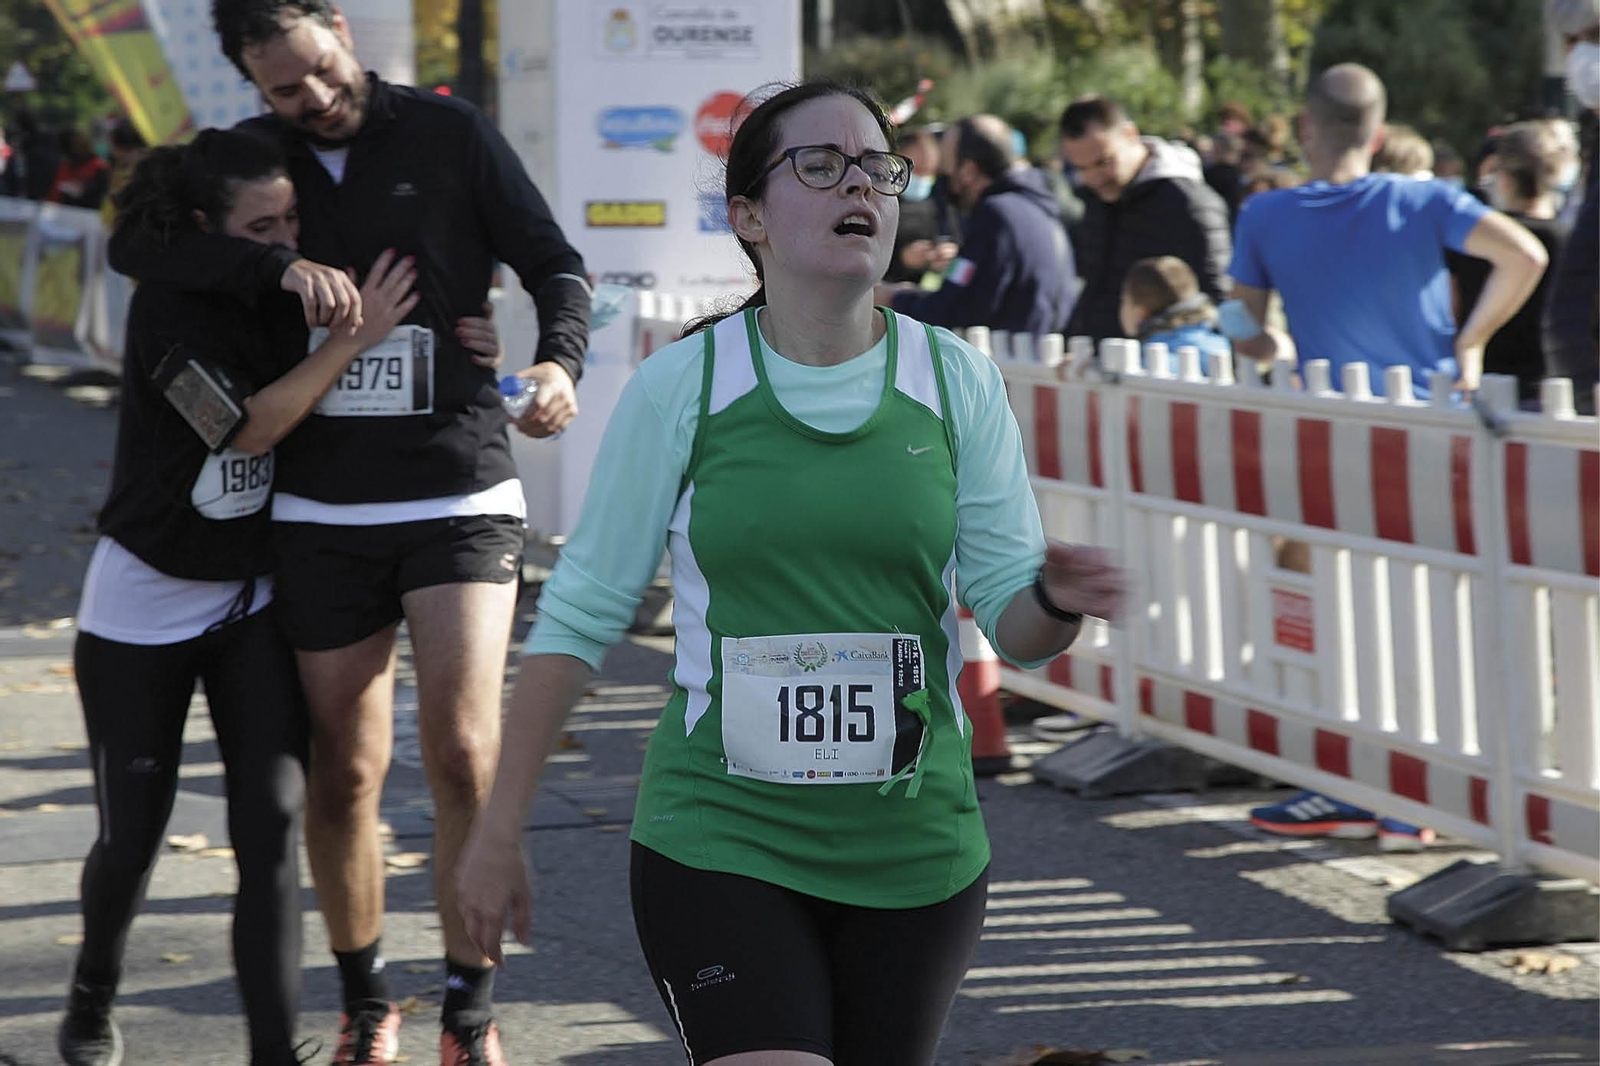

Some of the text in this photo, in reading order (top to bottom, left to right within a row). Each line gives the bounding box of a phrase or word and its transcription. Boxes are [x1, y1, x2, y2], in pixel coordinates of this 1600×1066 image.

[653, 24, 755, 42] OURENSE
[220, 456, 272, 494] 1983
[850, 649, 889, 661] CaixaBank
[777, 684, 875, 742] 1815
[813, 748, 839, 761] ELI
